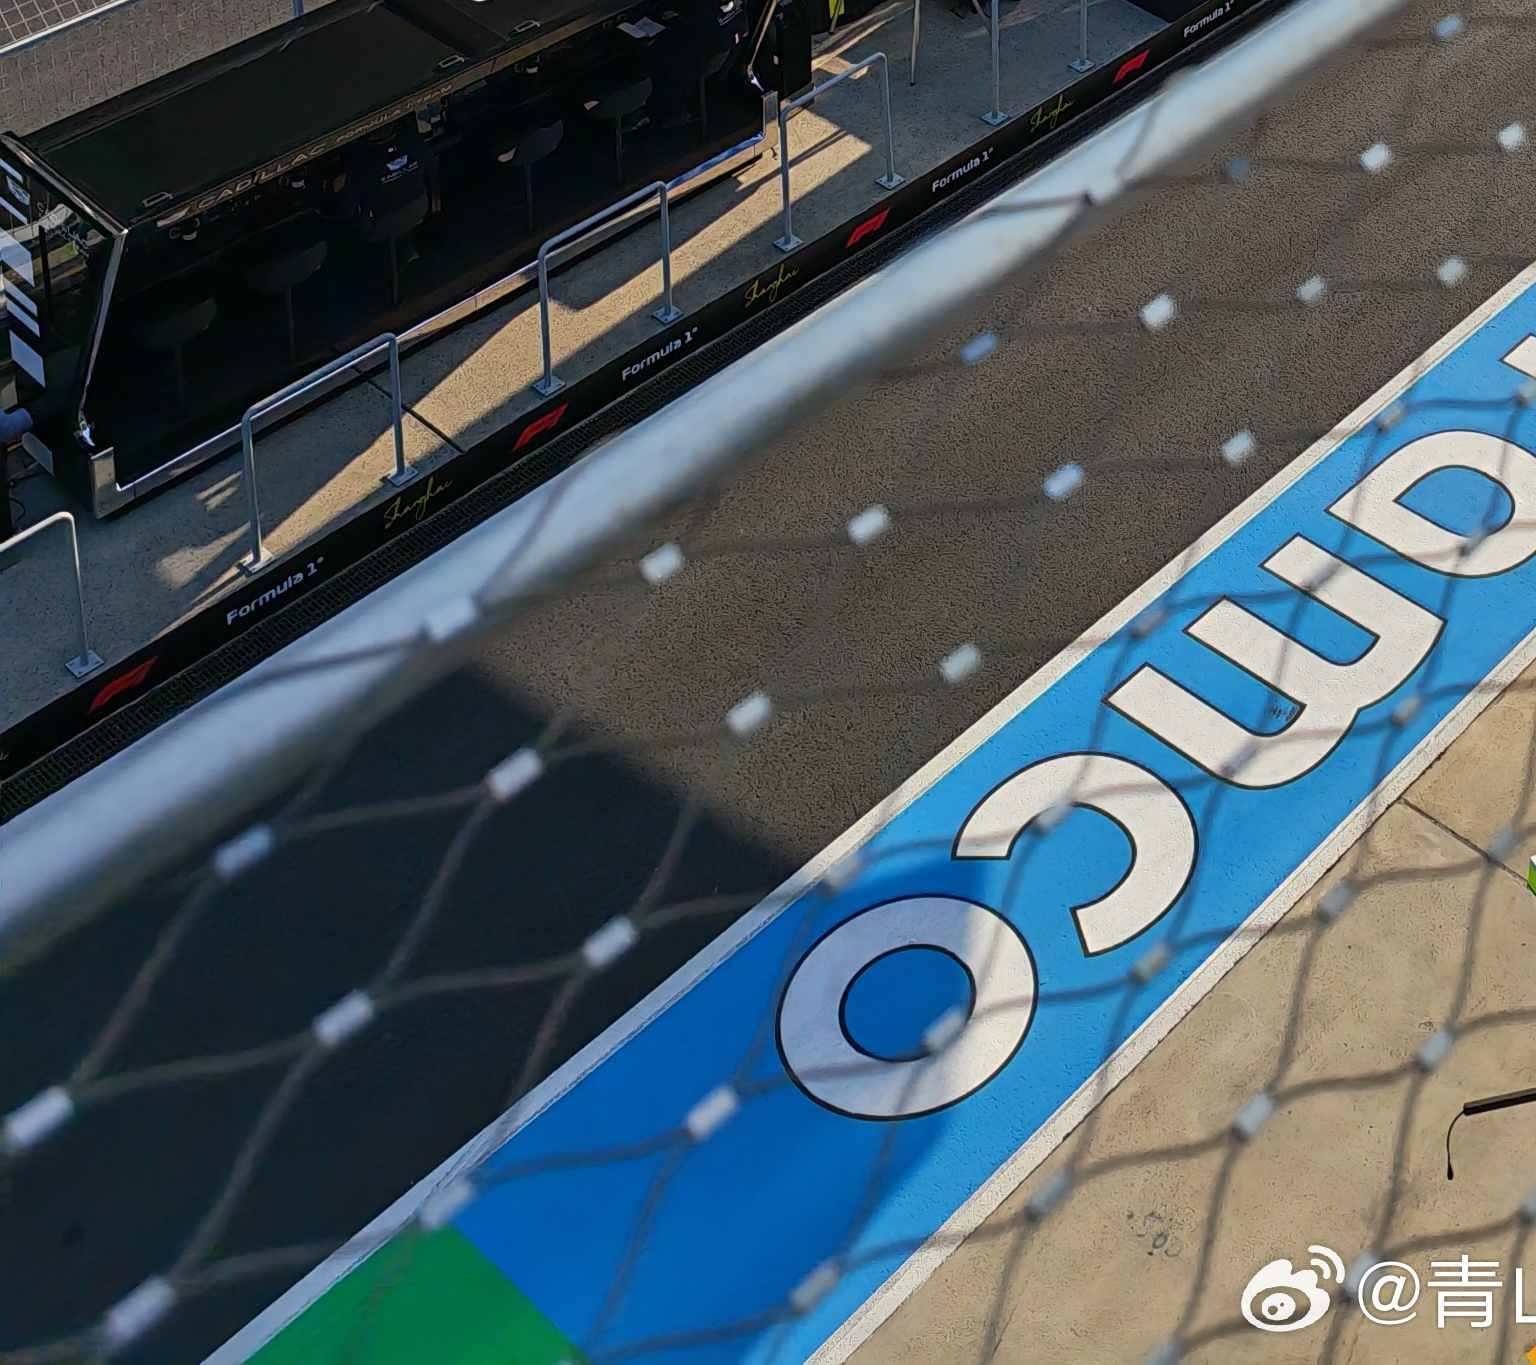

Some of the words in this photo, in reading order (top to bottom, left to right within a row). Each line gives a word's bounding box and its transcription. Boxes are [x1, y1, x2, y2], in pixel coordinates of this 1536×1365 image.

[1184, 8, 1224, 38] Formula
[199, 141, 327, 209] CADILLAC
[931, 156, 981, 193] Formula
[622, 338, 682, 382] Formula
[226, 571, 304, 626] Formula
